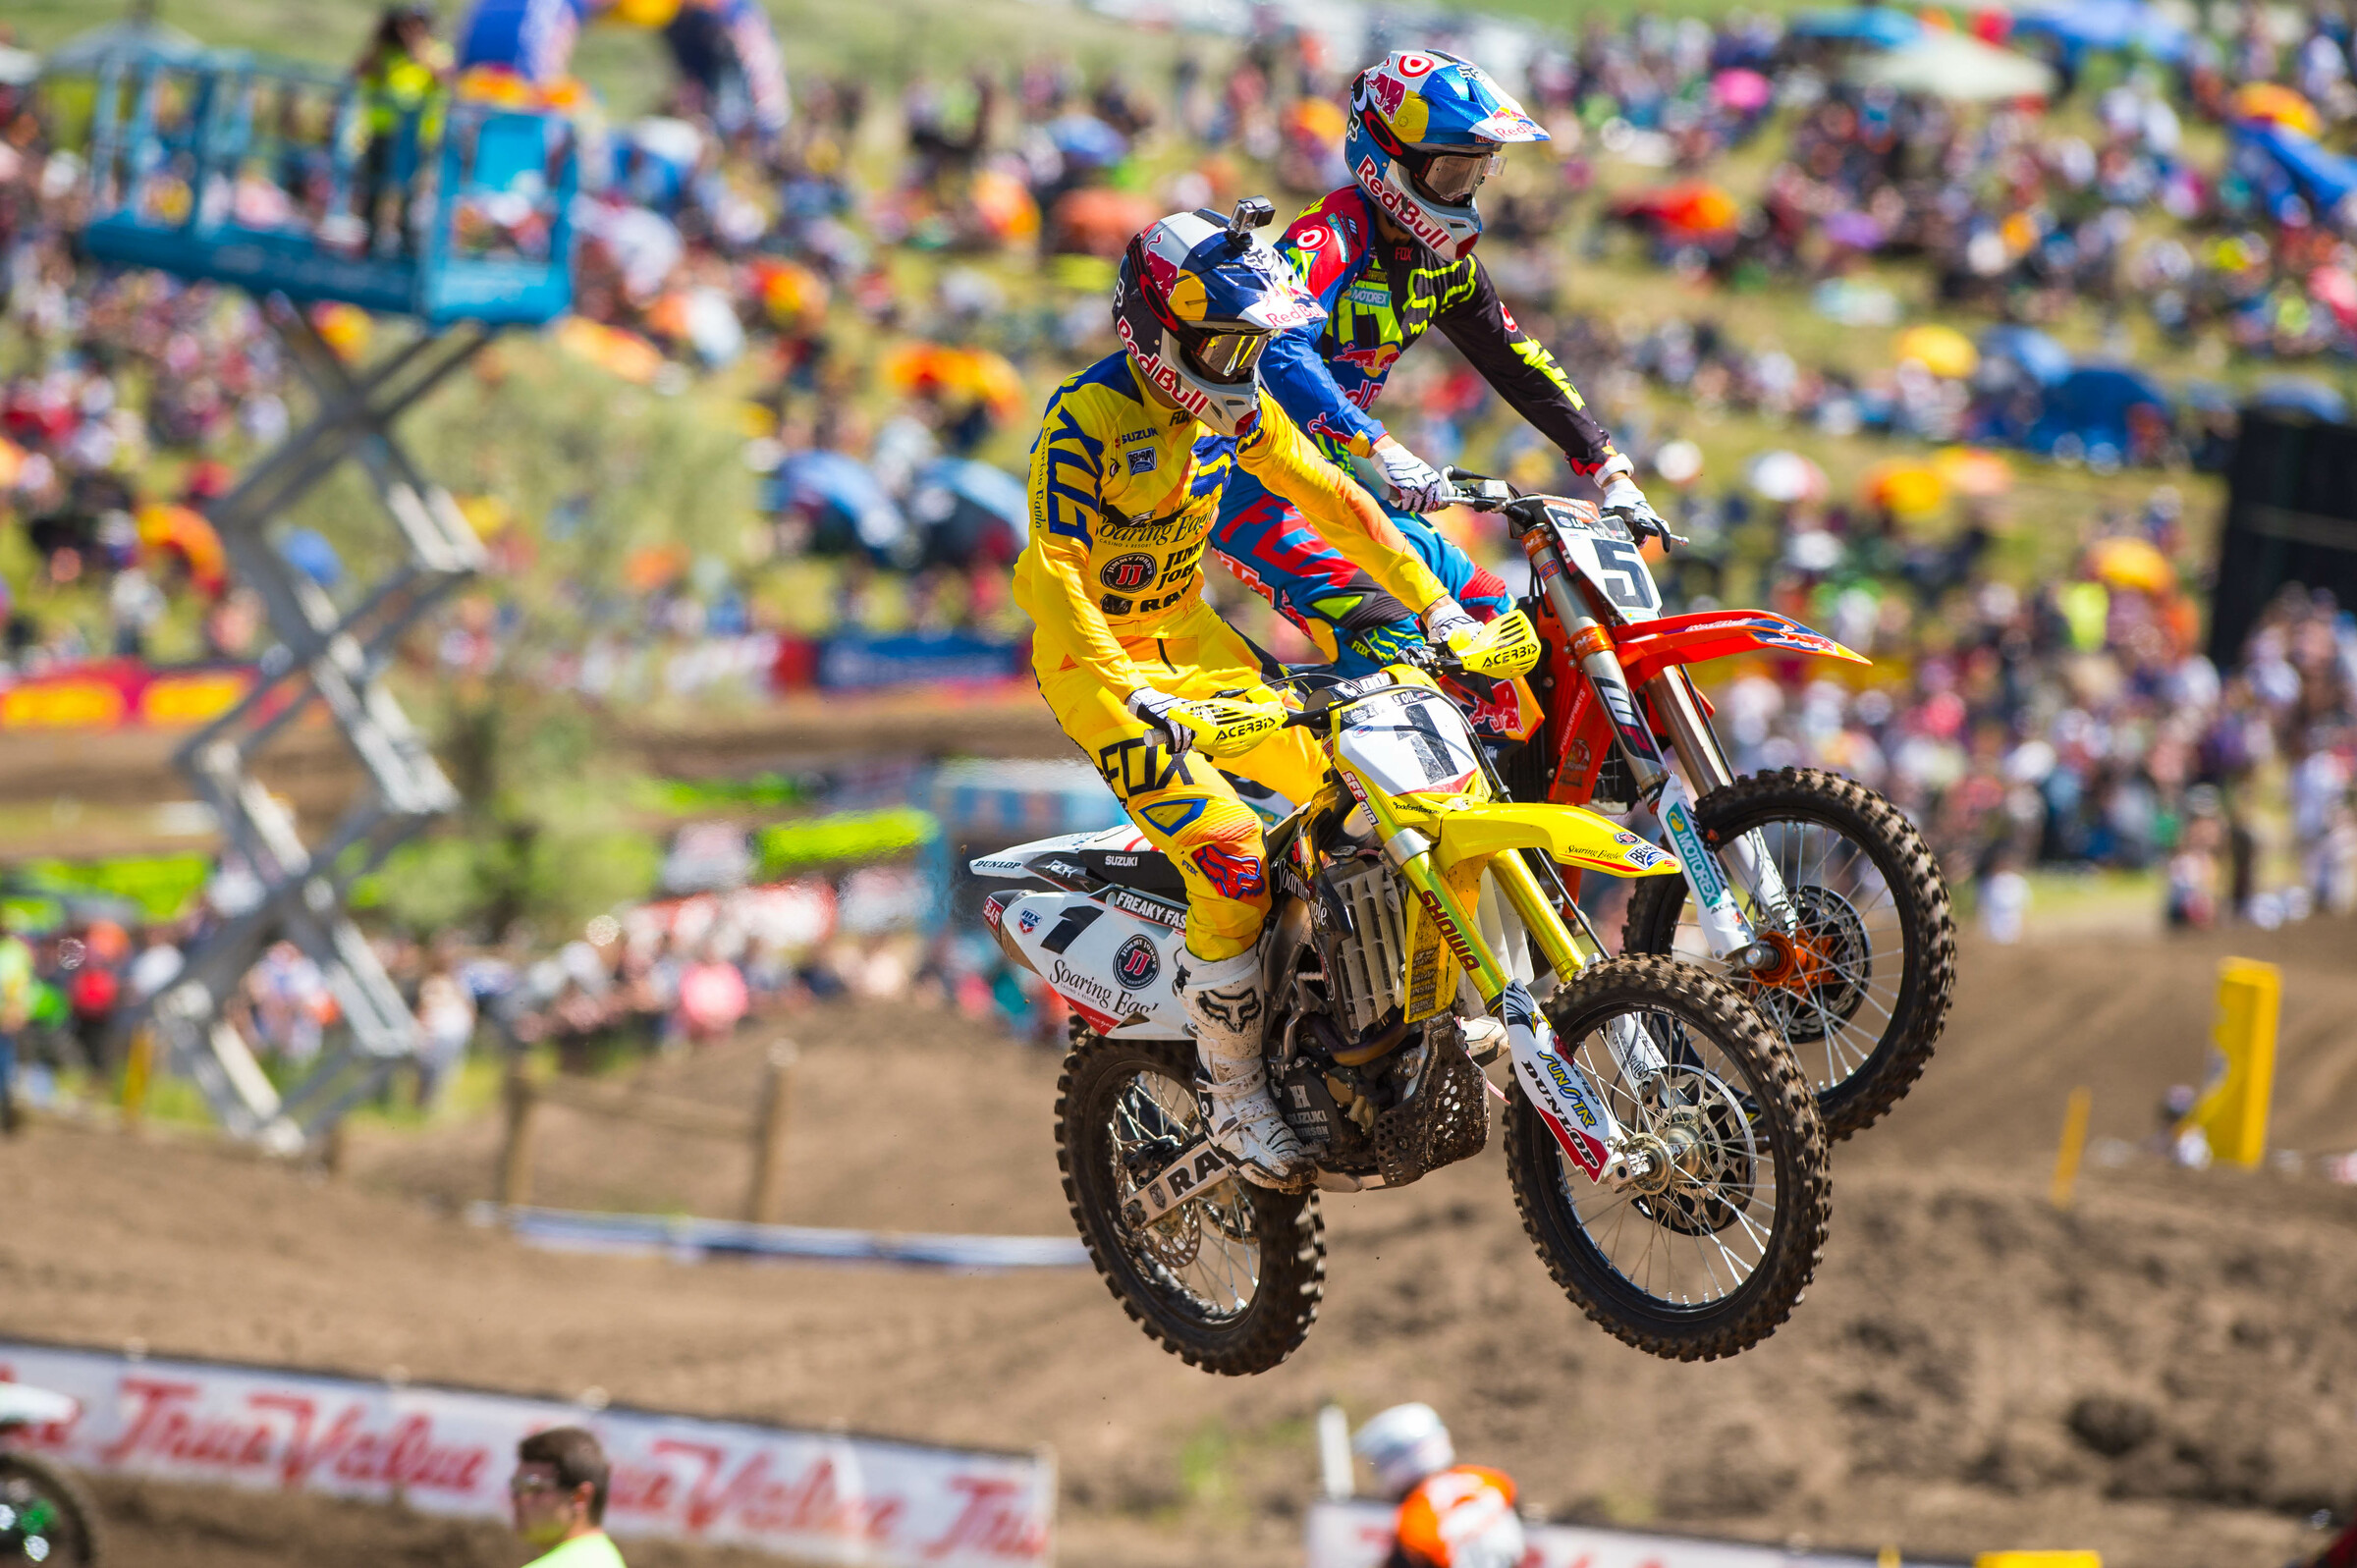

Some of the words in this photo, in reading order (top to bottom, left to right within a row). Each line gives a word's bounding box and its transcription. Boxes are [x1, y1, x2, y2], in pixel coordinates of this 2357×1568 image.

[1395, 246, 1413, 262] FOX
[1351, 289, 1387, 304] MOTOREX
[1094, 514, 1172, 546] Soaring
[1116, 564, 1144, 585] JJ
[1591, 538, 1654, 610] 5
[1350, 639, 1371, 658] FOX
[1482, 643, 1538, 670] ACERBIS
[1216, 718, 1276, 740] ACERBIS
[1099, 737, 1195, 796] FOX
[1105, 855, 1138, 868] SUZUKI
[1565, 844, 1599, 857] Soaring
[973, 859, 1021, 870] DUNLOP
[1676, 834, 1720, 904] MOTOREX
[1116, 892, 1165, 922] FREAKY
[1163, 908, 1187, 930] FAS
[1040, 905, 1105, 955] 1
[1418, 889, 1480, 971] SHOWA
[1124, 948, 1151, 976] JJ
[1049, 958, 1113, 1009] Soaring
[1288, 1084, 1312, 1108] H
[1286, 1109, 1329, 1125] SUZUKI
[1521, 1059, 1600, 1169] DUNLOP
[1166, 1149, 1226, 1199] RA
